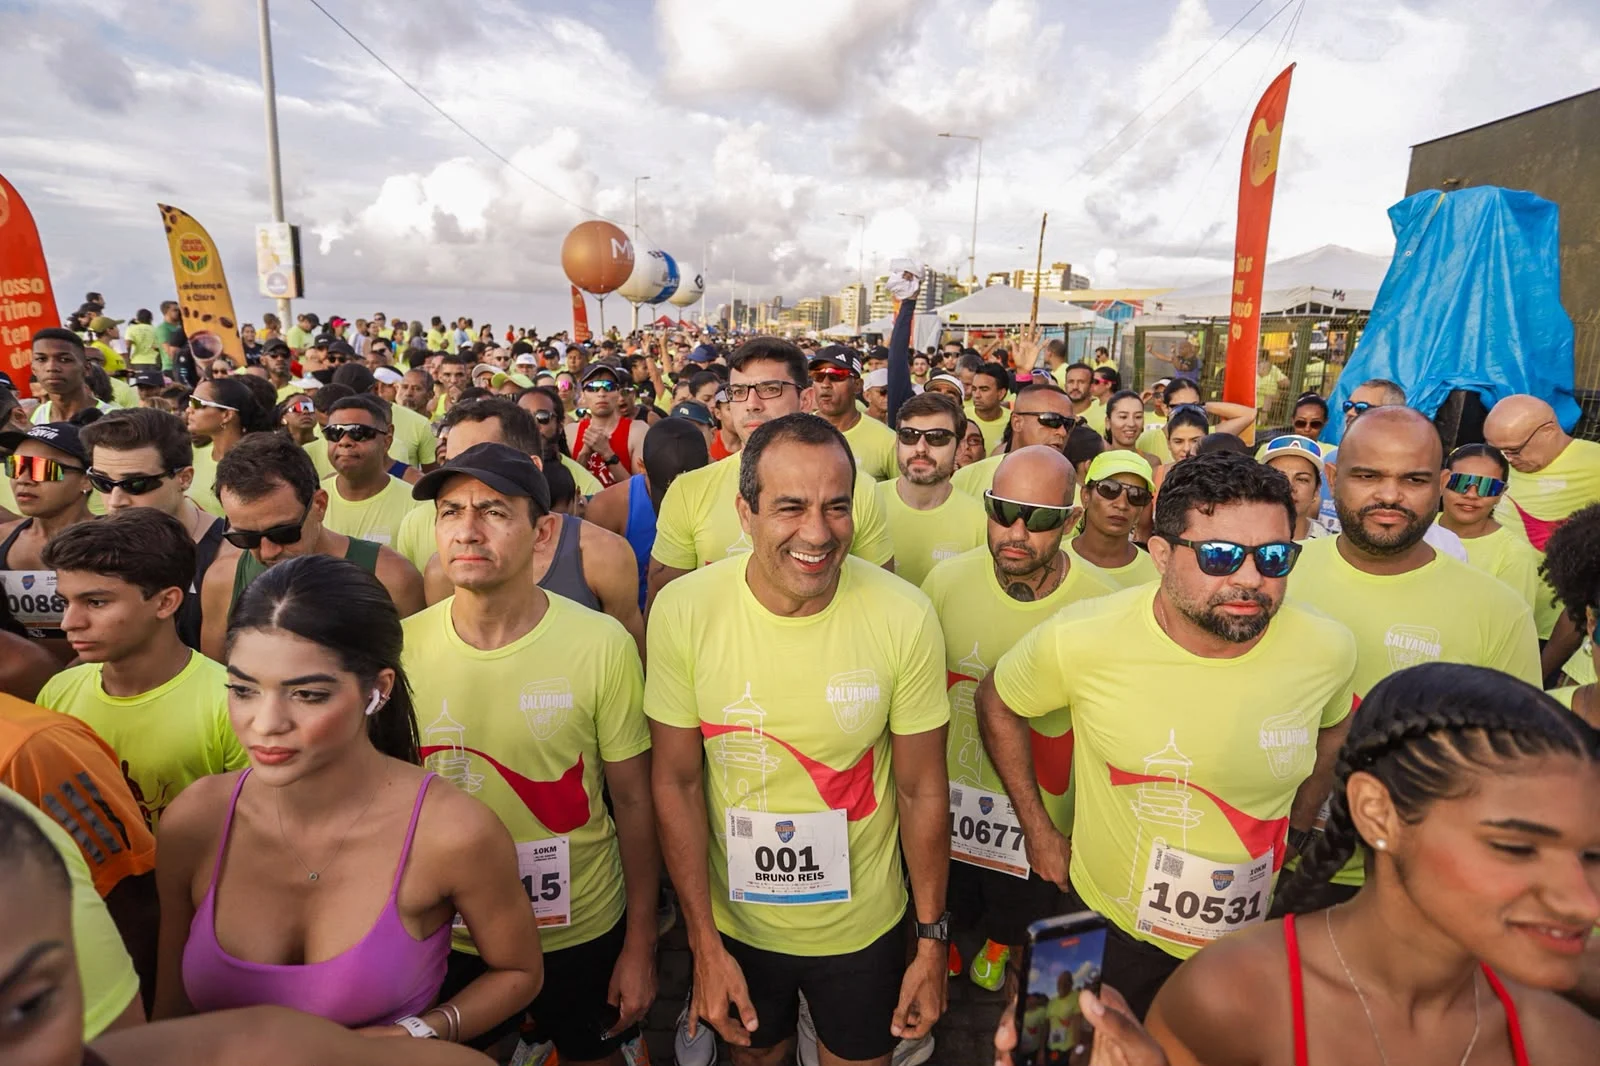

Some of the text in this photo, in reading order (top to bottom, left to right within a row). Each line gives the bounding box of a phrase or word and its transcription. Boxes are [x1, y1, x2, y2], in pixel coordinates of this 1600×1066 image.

[1385, 632, 1440, 656] SALVADOR
[520, 693, 573, 709] SALVADOR
[827, 685, 880, 702] SALVADOR
[533, 845, 557, 855] 10KM
[755, 846, 820, 873] 001
[755, 871, 825, 882] BRUNO REIS
[1148, 882, 1262, 925] 10531
